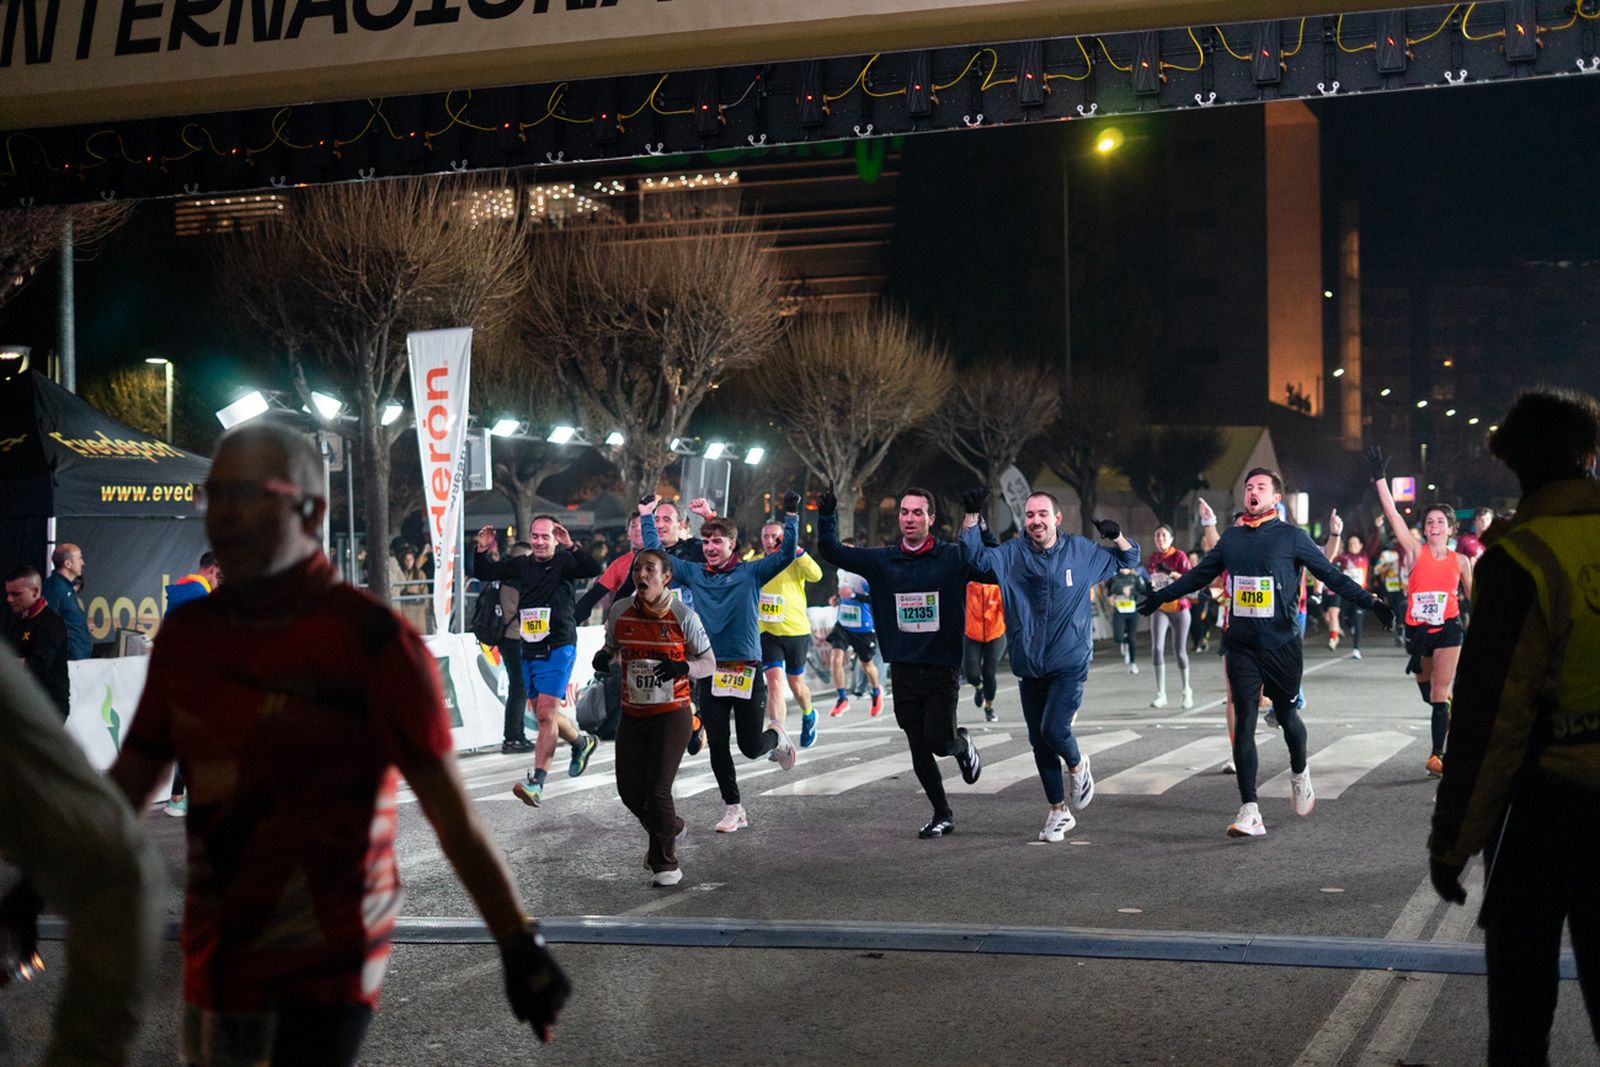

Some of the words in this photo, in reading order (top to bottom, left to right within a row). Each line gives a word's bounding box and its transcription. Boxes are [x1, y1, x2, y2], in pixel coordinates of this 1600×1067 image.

[1241, 591, 1263, 604] 4718
[762, 603, 779, 613] 4241
[903, 606, 933, 619] 12135
[1422, 604, 1439, 614] 233
[527, 620, 542, 631] 1671
[636, 675, 662, 688] 6174
[721, 674, 745, 687] 4719
